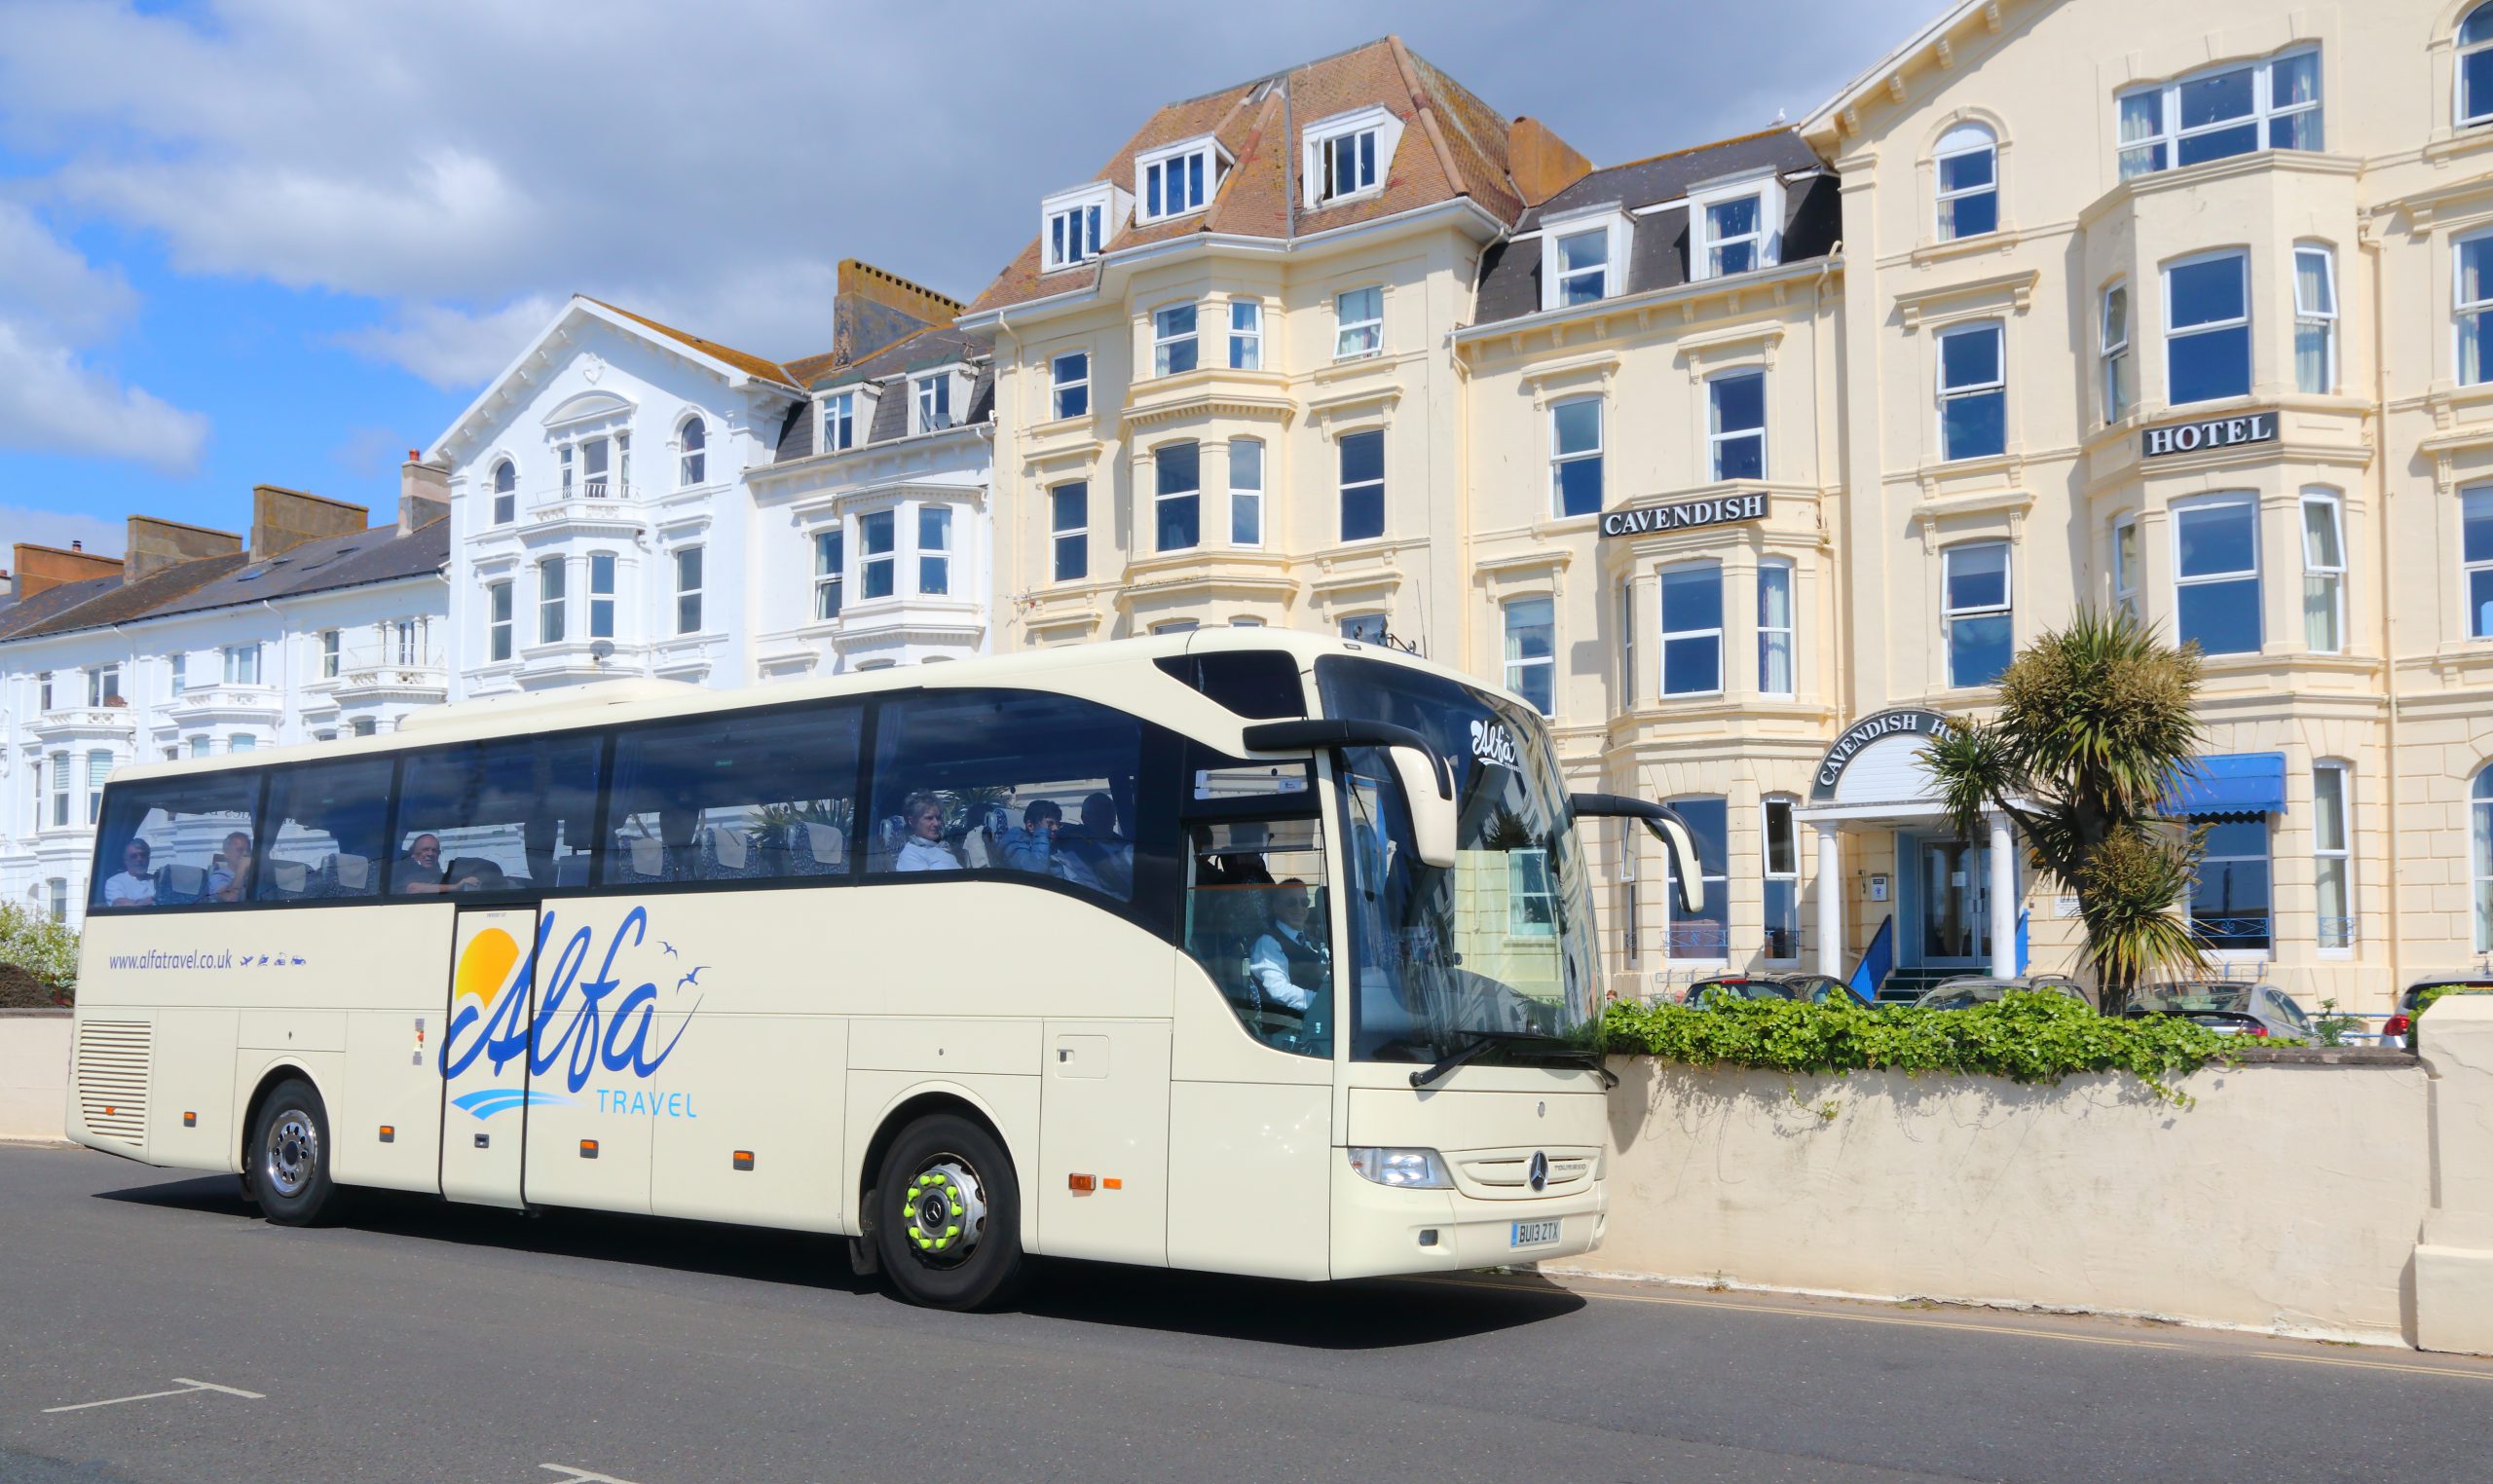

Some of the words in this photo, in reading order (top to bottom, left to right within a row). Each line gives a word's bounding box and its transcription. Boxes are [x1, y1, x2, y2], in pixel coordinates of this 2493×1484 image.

[2148, 416, 2272, 455] HOTEL
[1605, 495, 1765, 536] CAVENDISH
[1471, 721, 1515, 762] Alfa
[1819, 714, 1918, 787] CAVENDISH
[109, 948, 233, 969] www.alfatravel.co.uk
[438, 906, 704, 1093] Alfa
[597, 1089, 697, 1118] TRAVEL
[1519, 1224, 1540, 1243] BU13
[1542, 1222, 1559, 1241] ZTX
